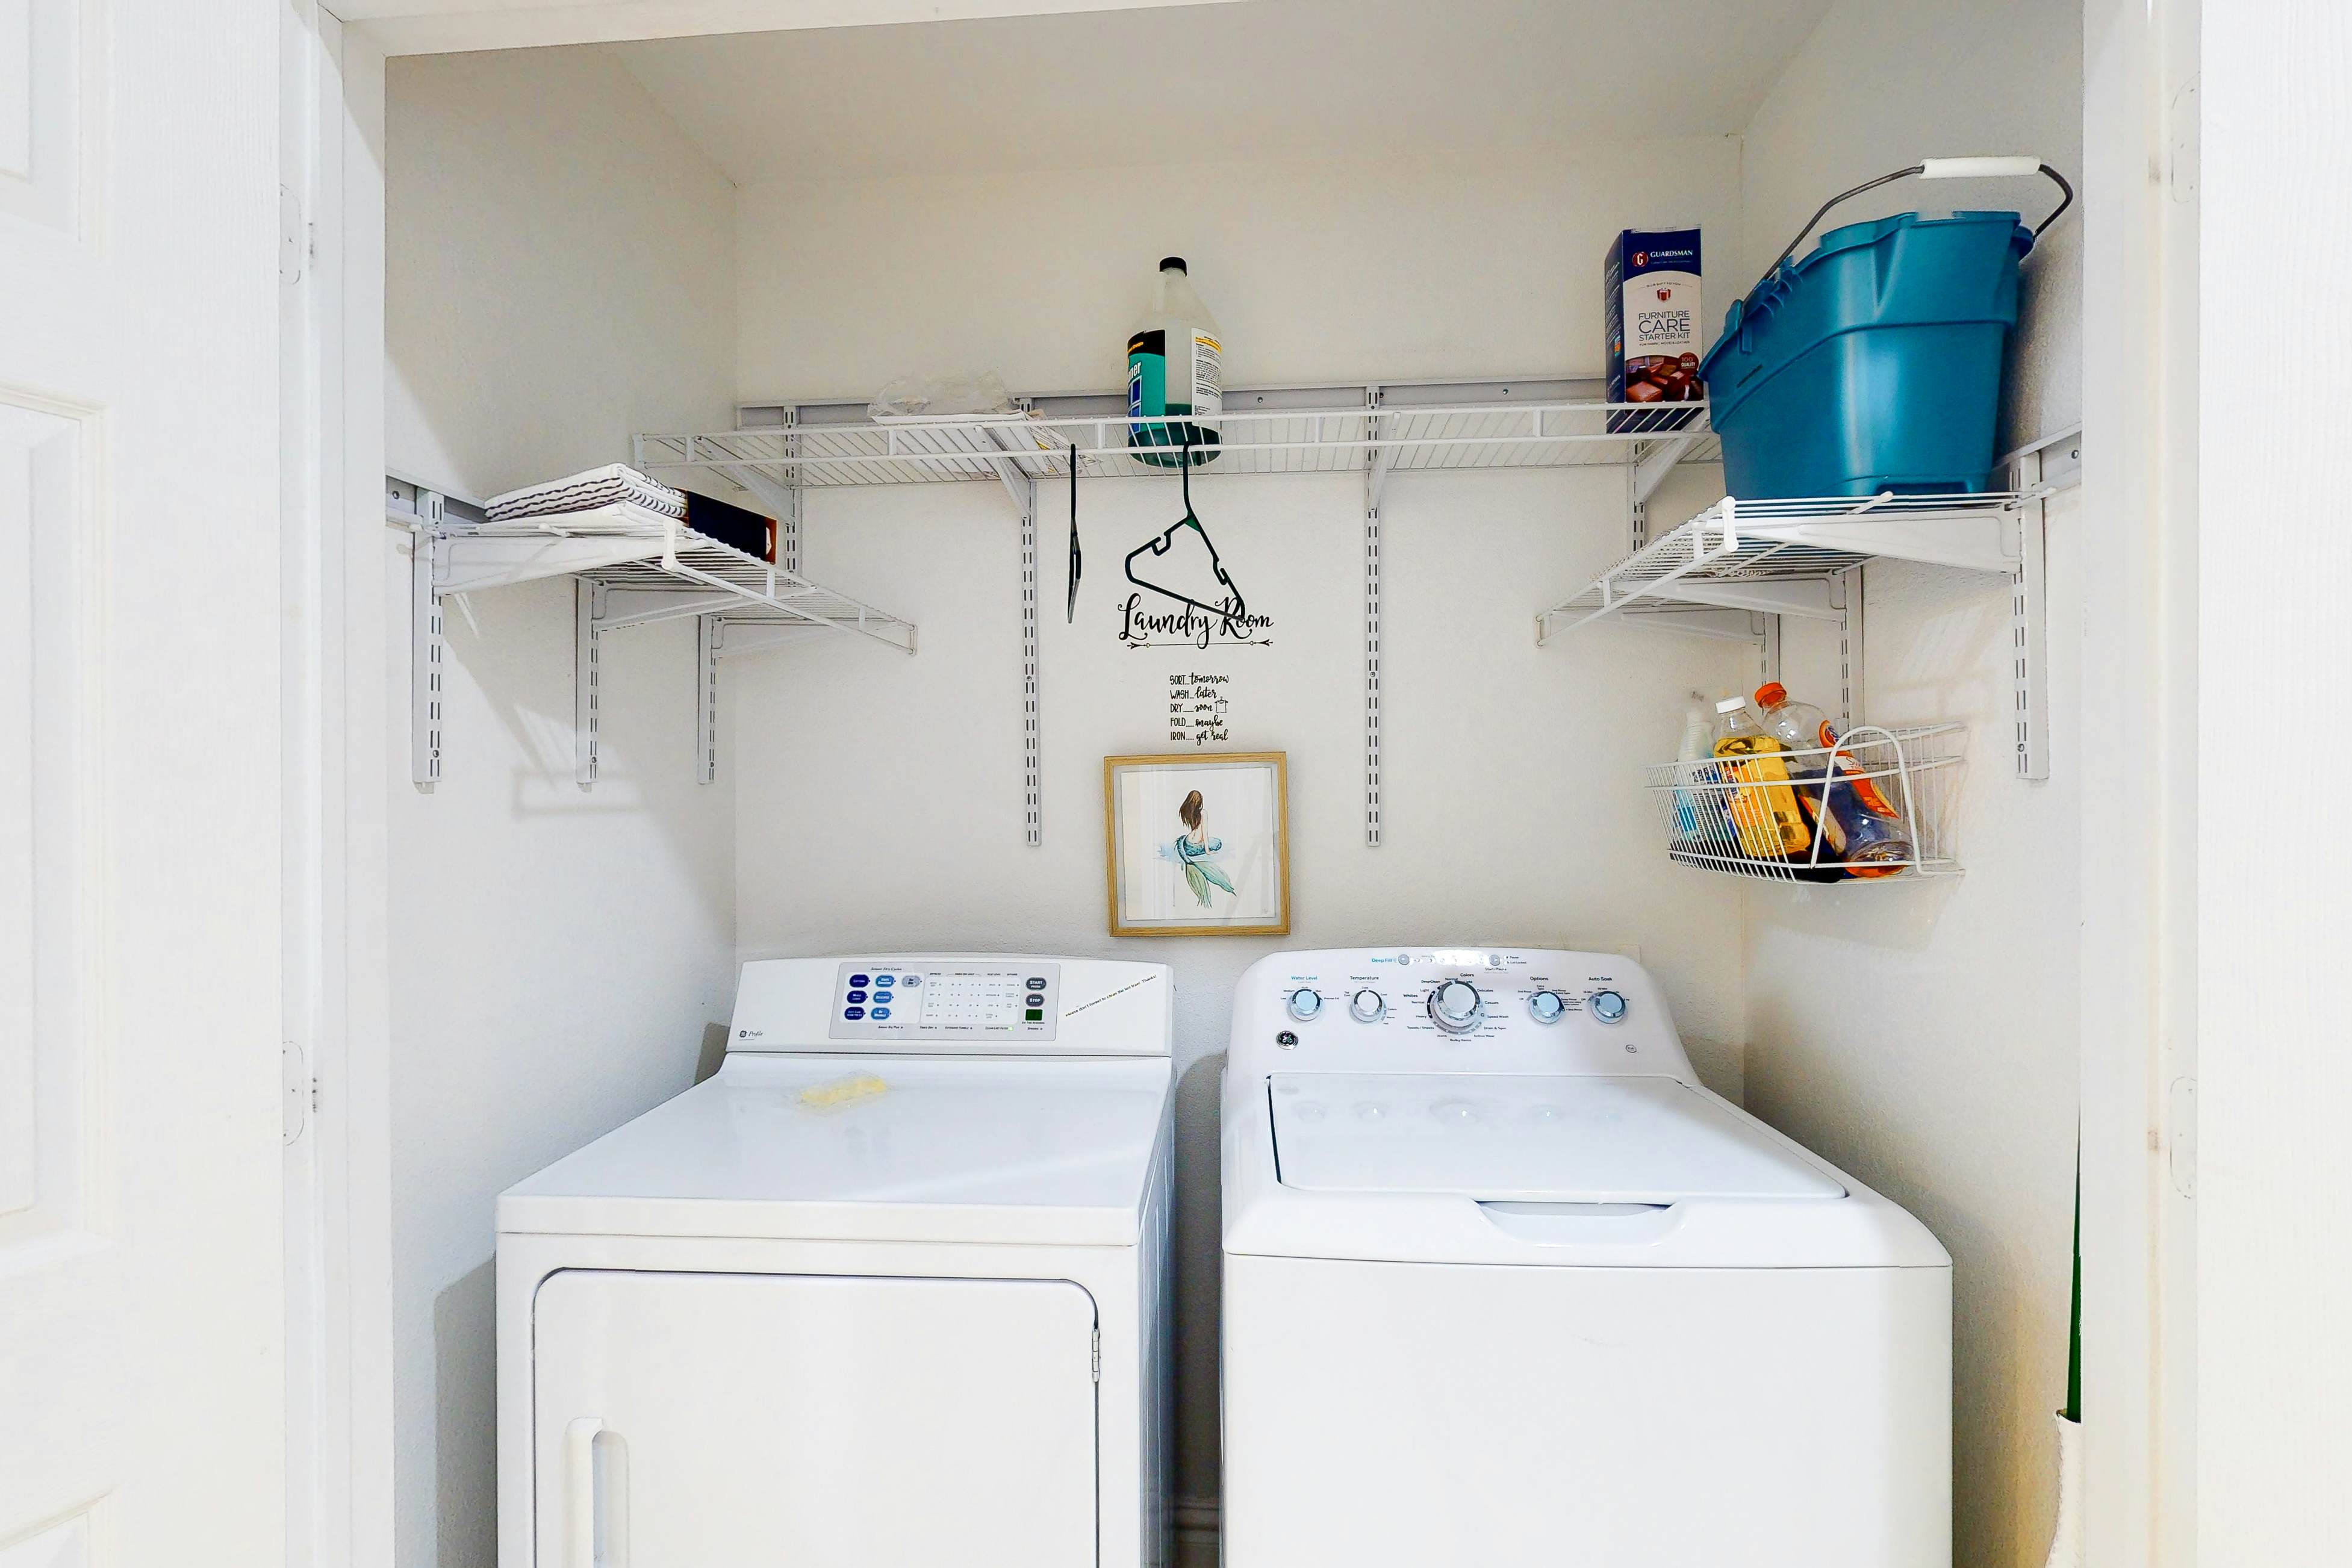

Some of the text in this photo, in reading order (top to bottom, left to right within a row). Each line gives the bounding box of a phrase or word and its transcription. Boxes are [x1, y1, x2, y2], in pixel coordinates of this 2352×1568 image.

[1638, 310, 1690, 320] FURNITURE
[1638, 319, 1690, 334] CARE
[1639, 332, 1676, 341] STARTER
[1118, 593, 1274, 649] Laundry Room
[1189, 672, 1229, 685] tomorrow
[1195, 686, 1217, 698] later
[1194, 703, 1213, 712] soon
[1195, 714, 1223, 732] maybe
[1196, 730, 1208, 746] get
[1211, 729, 1228, 741] real
